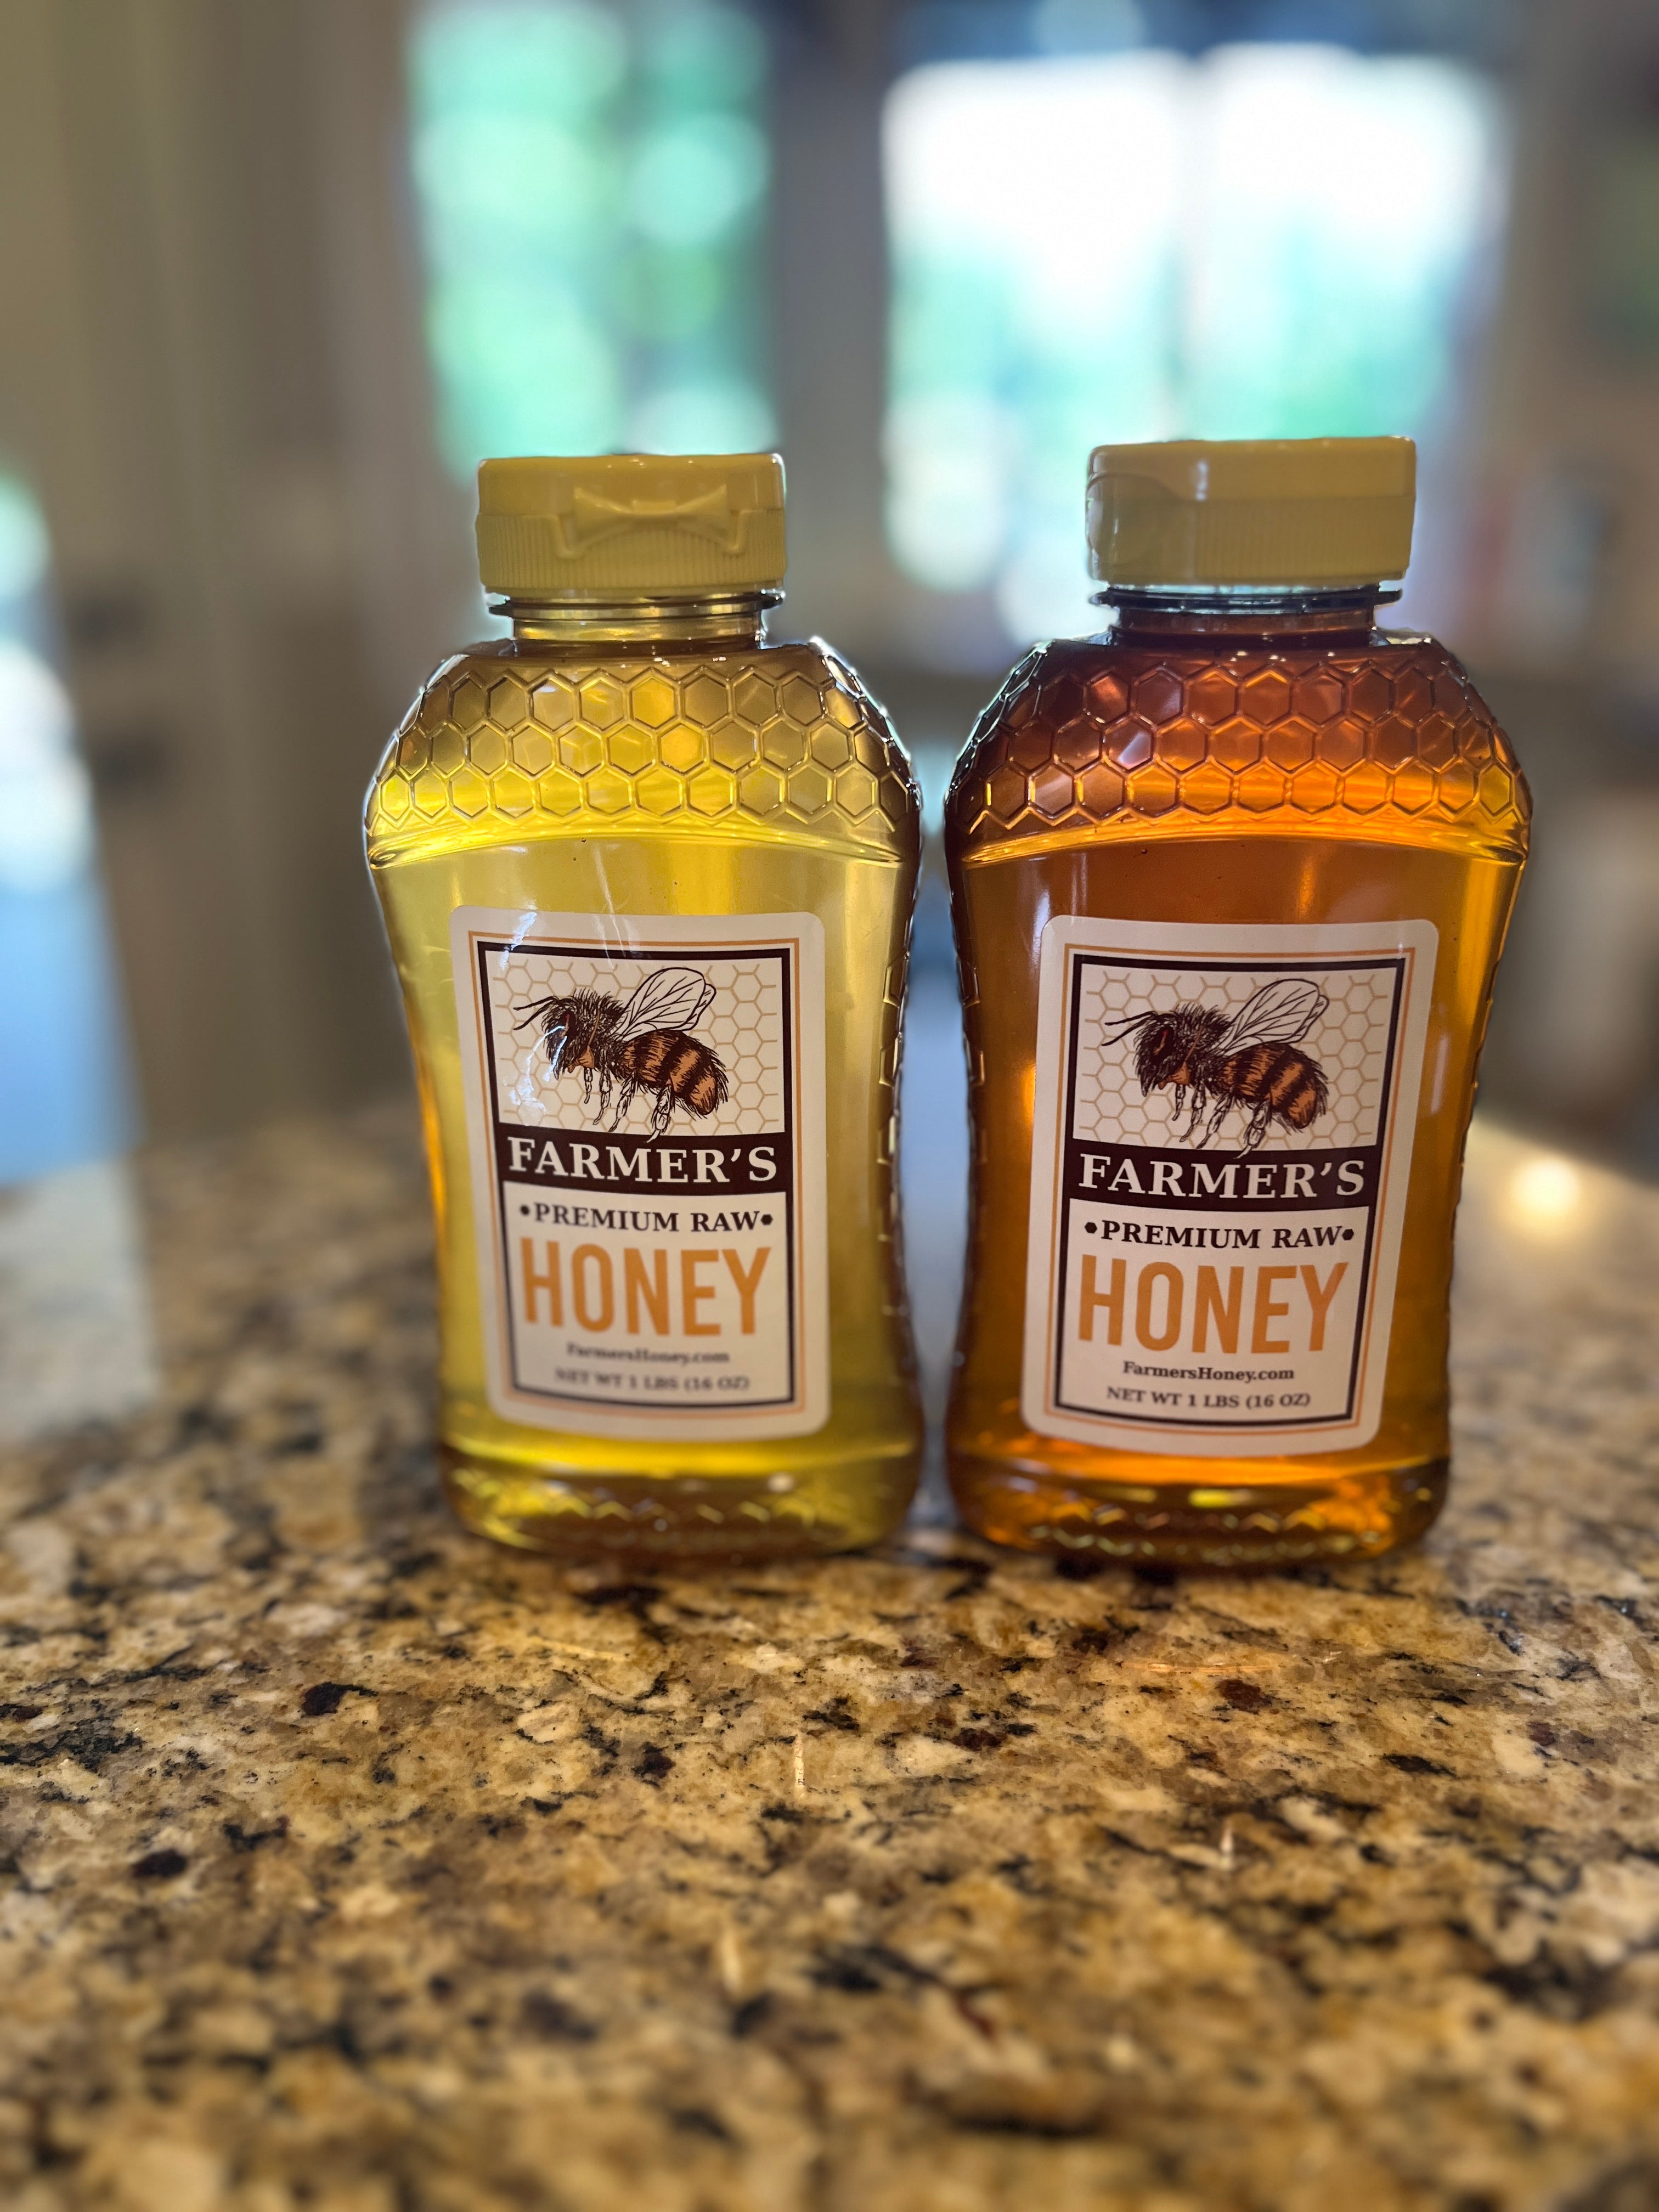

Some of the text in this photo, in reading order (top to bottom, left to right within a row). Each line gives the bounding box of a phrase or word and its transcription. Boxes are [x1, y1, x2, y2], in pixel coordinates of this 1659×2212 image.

[534, 1203, 760, 1232] PREMIUM RAW
[1101, 1220, 1342, 1248] PREMIUM RAW
[520, 1237, 771, 1337] HONEY
[1078, 1254, 1348, 1353] HONEY
[1123, 1361, 1294, 1382] FarmersHoney.com
[1107, 1387, 1311, 1409] NET WT 1 LBS (16 OZ)
